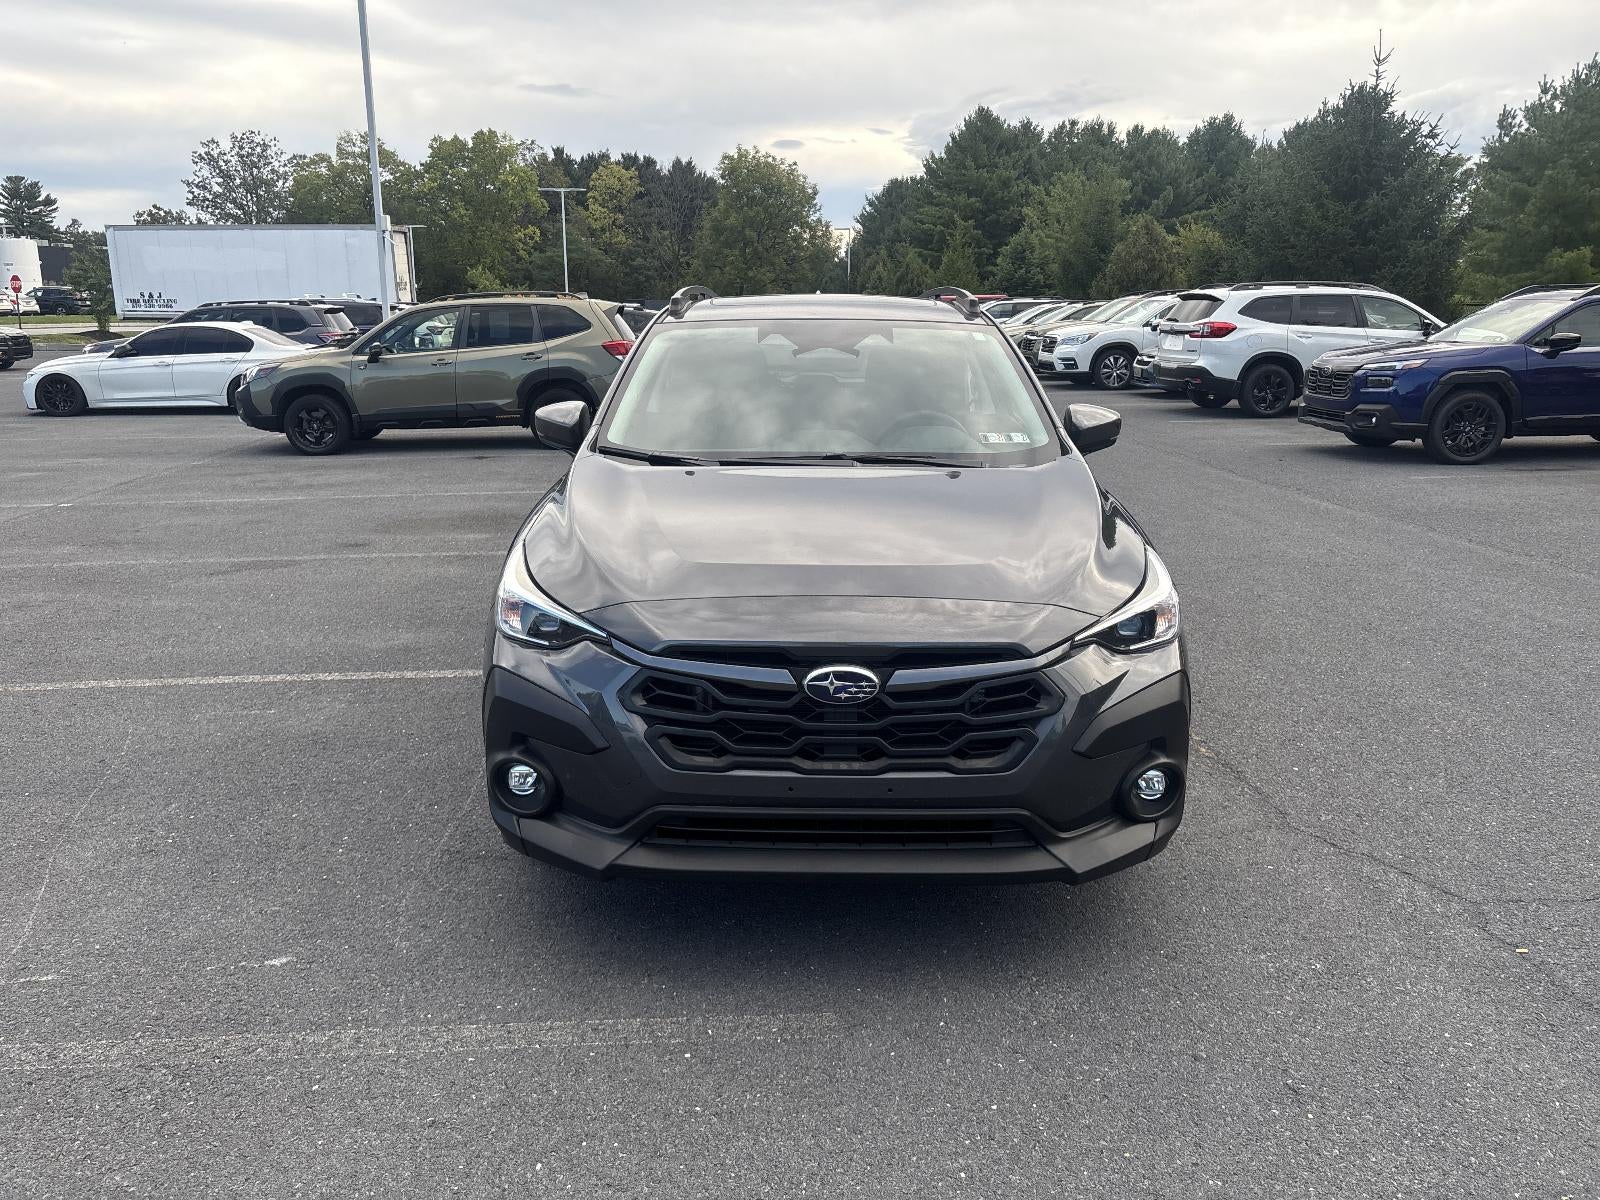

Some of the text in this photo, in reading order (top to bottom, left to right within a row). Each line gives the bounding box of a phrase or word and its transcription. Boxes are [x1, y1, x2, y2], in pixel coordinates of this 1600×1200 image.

[139, 291, 162, 299] S & J
